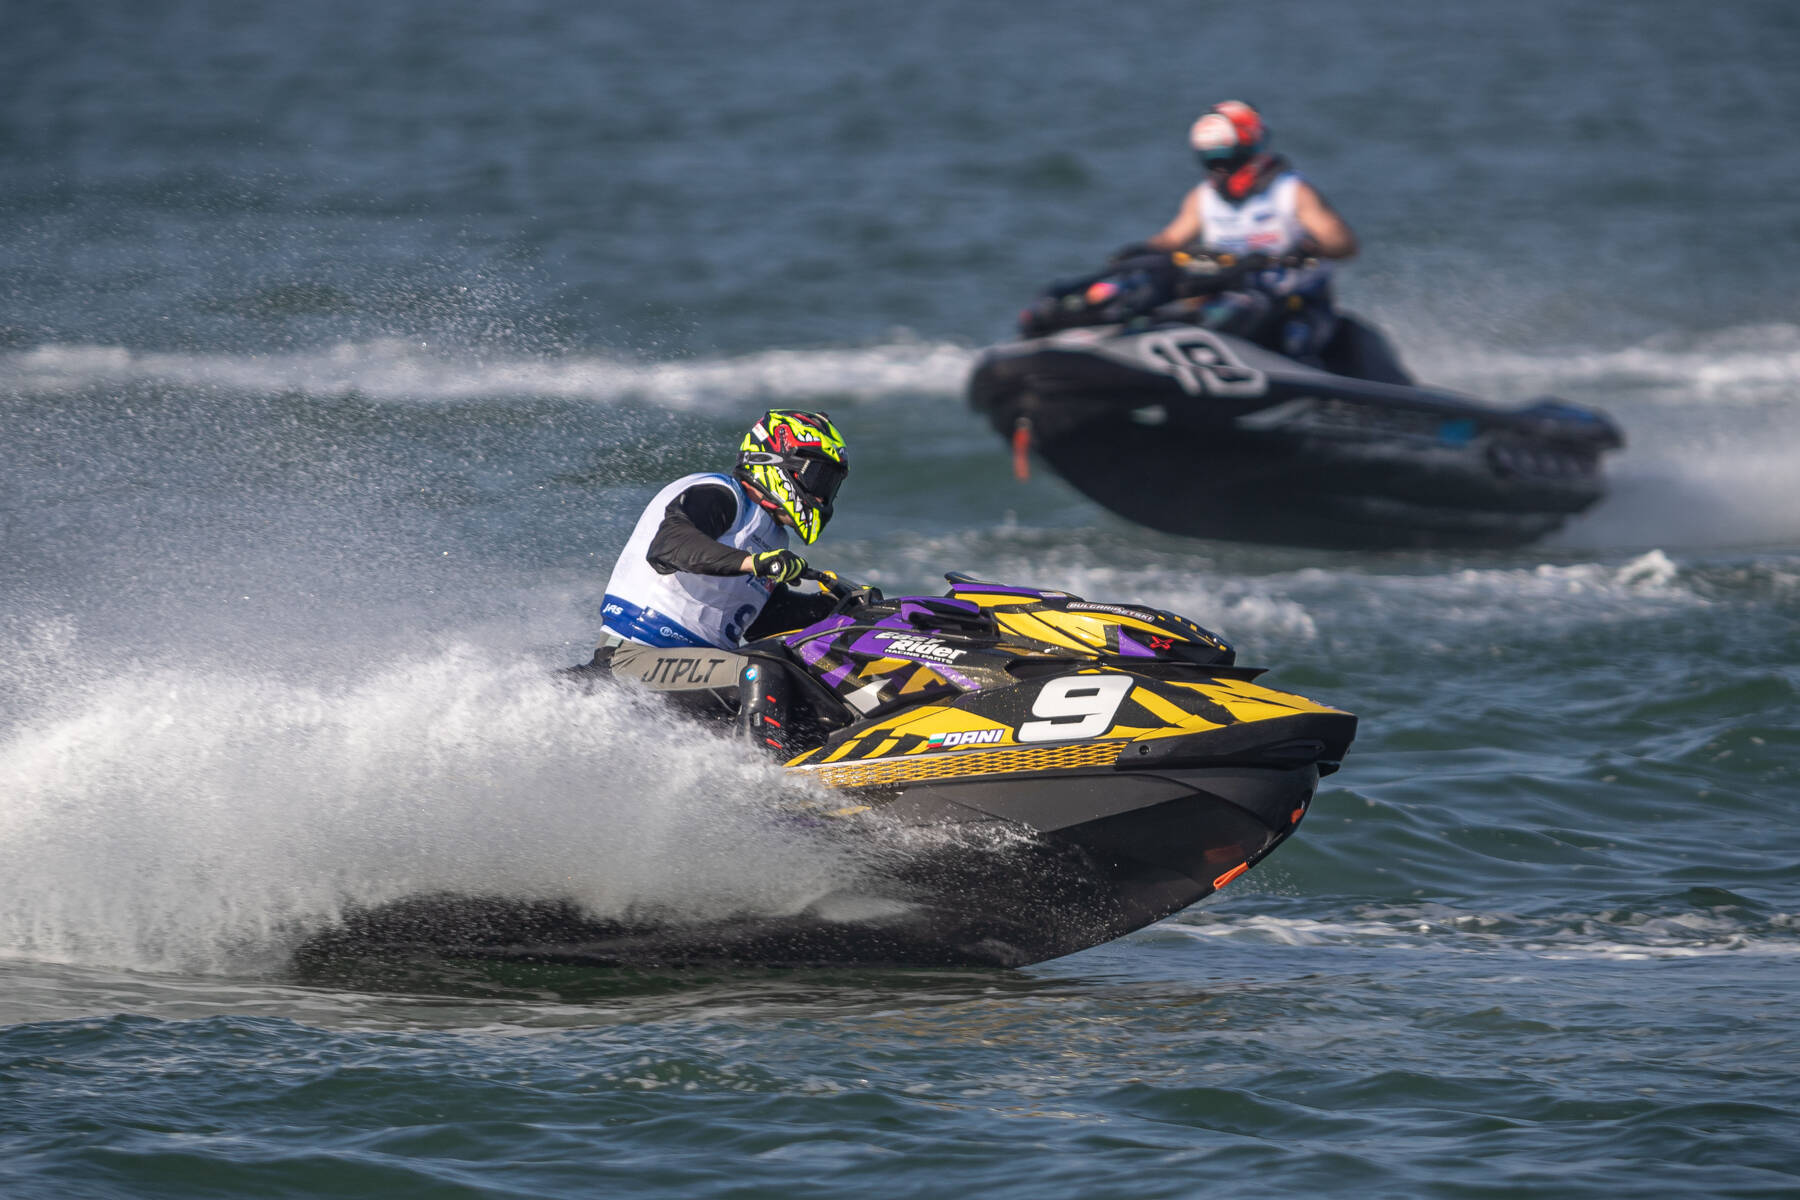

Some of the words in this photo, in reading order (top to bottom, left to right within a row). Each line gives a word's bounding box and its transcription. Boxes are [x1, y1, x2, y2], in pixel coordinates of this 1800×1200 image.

[888, 640, 967, 660] Rider
[921, 654, 953, 664] PARTS
[641, 658, 726, 683] JTPLT
[1018, 675, 1134, 742] 9
[943, 729, 1005, 747] DANI
